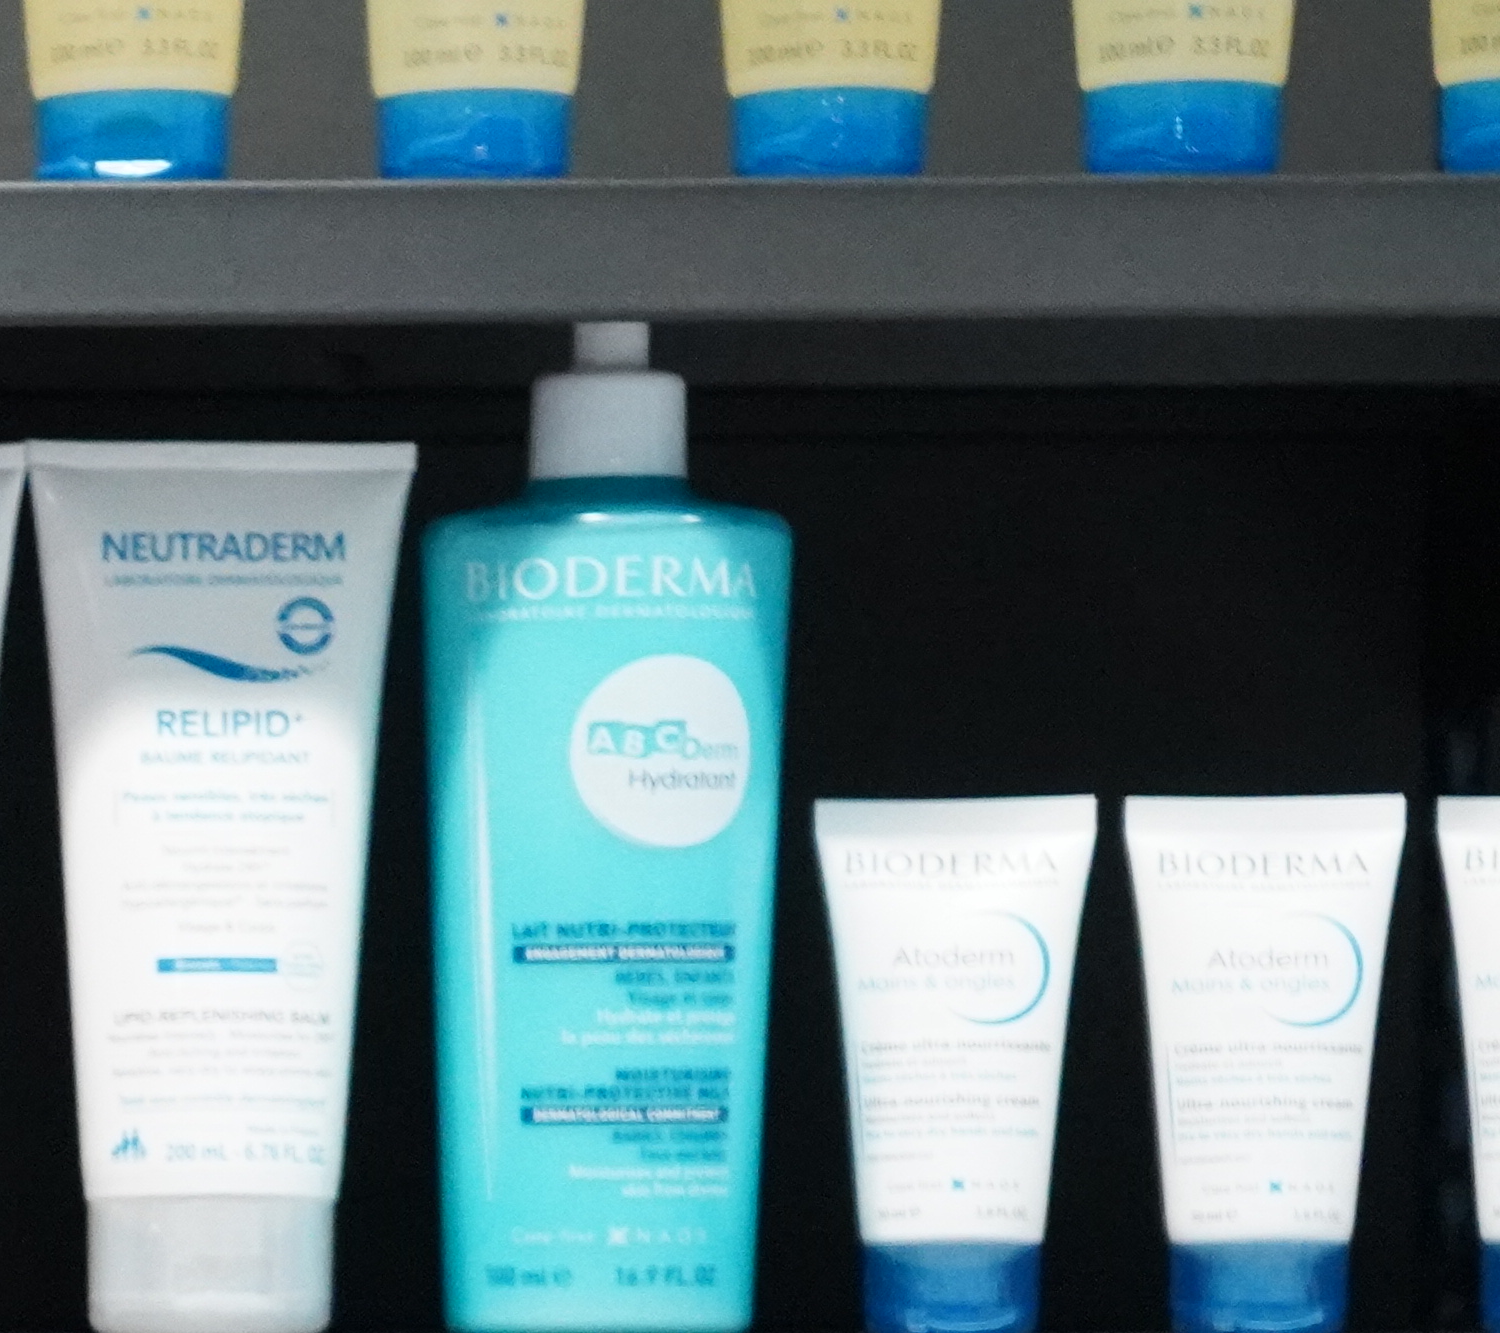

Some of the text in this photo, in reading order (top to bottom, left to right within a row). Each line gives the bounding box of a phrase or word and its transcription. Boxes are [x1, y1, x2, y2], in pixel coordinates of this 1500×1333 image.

[102, 531, 346, 563] NEUTRADERM
[466, 556, 758, 601] BIODERMA
[629, 768, 736, 793] Hydratant
[845, 850, 1058, 879] BIODERMA
[1158, 850, 1369, 877] BIODERMA
[892, 945, 1016, 968] Atoderm
[1207, 947, 1329, 969] Atoderm
